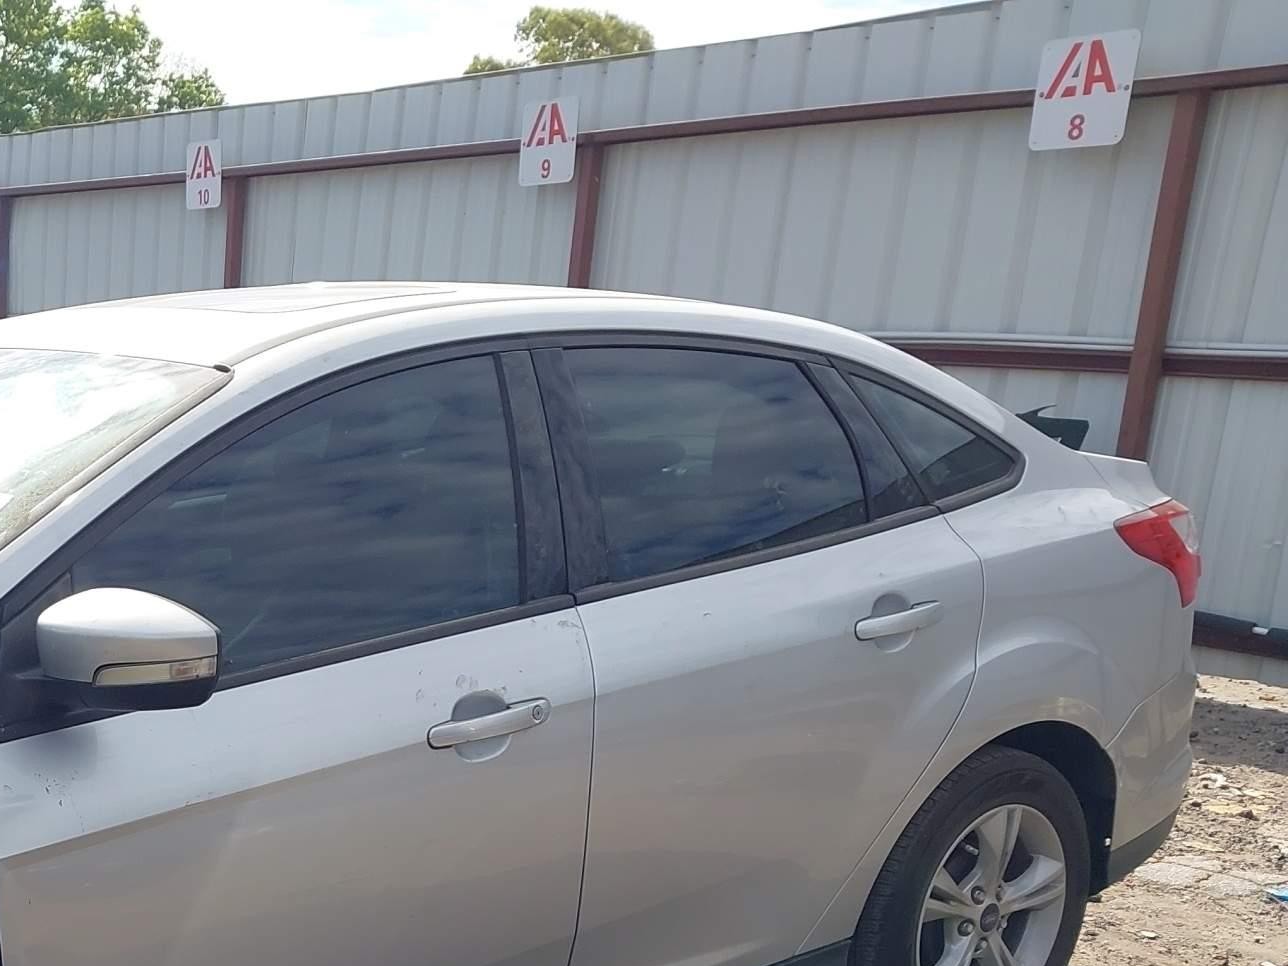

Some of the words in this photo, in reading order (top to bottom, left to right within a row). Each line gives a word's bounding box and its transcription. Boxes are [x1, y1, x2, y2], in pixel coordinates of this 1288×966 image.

[1068, 114, 1085, 140] 8
[541, 159, 551, 179] 9
[198, 189, 210, 206] 10
